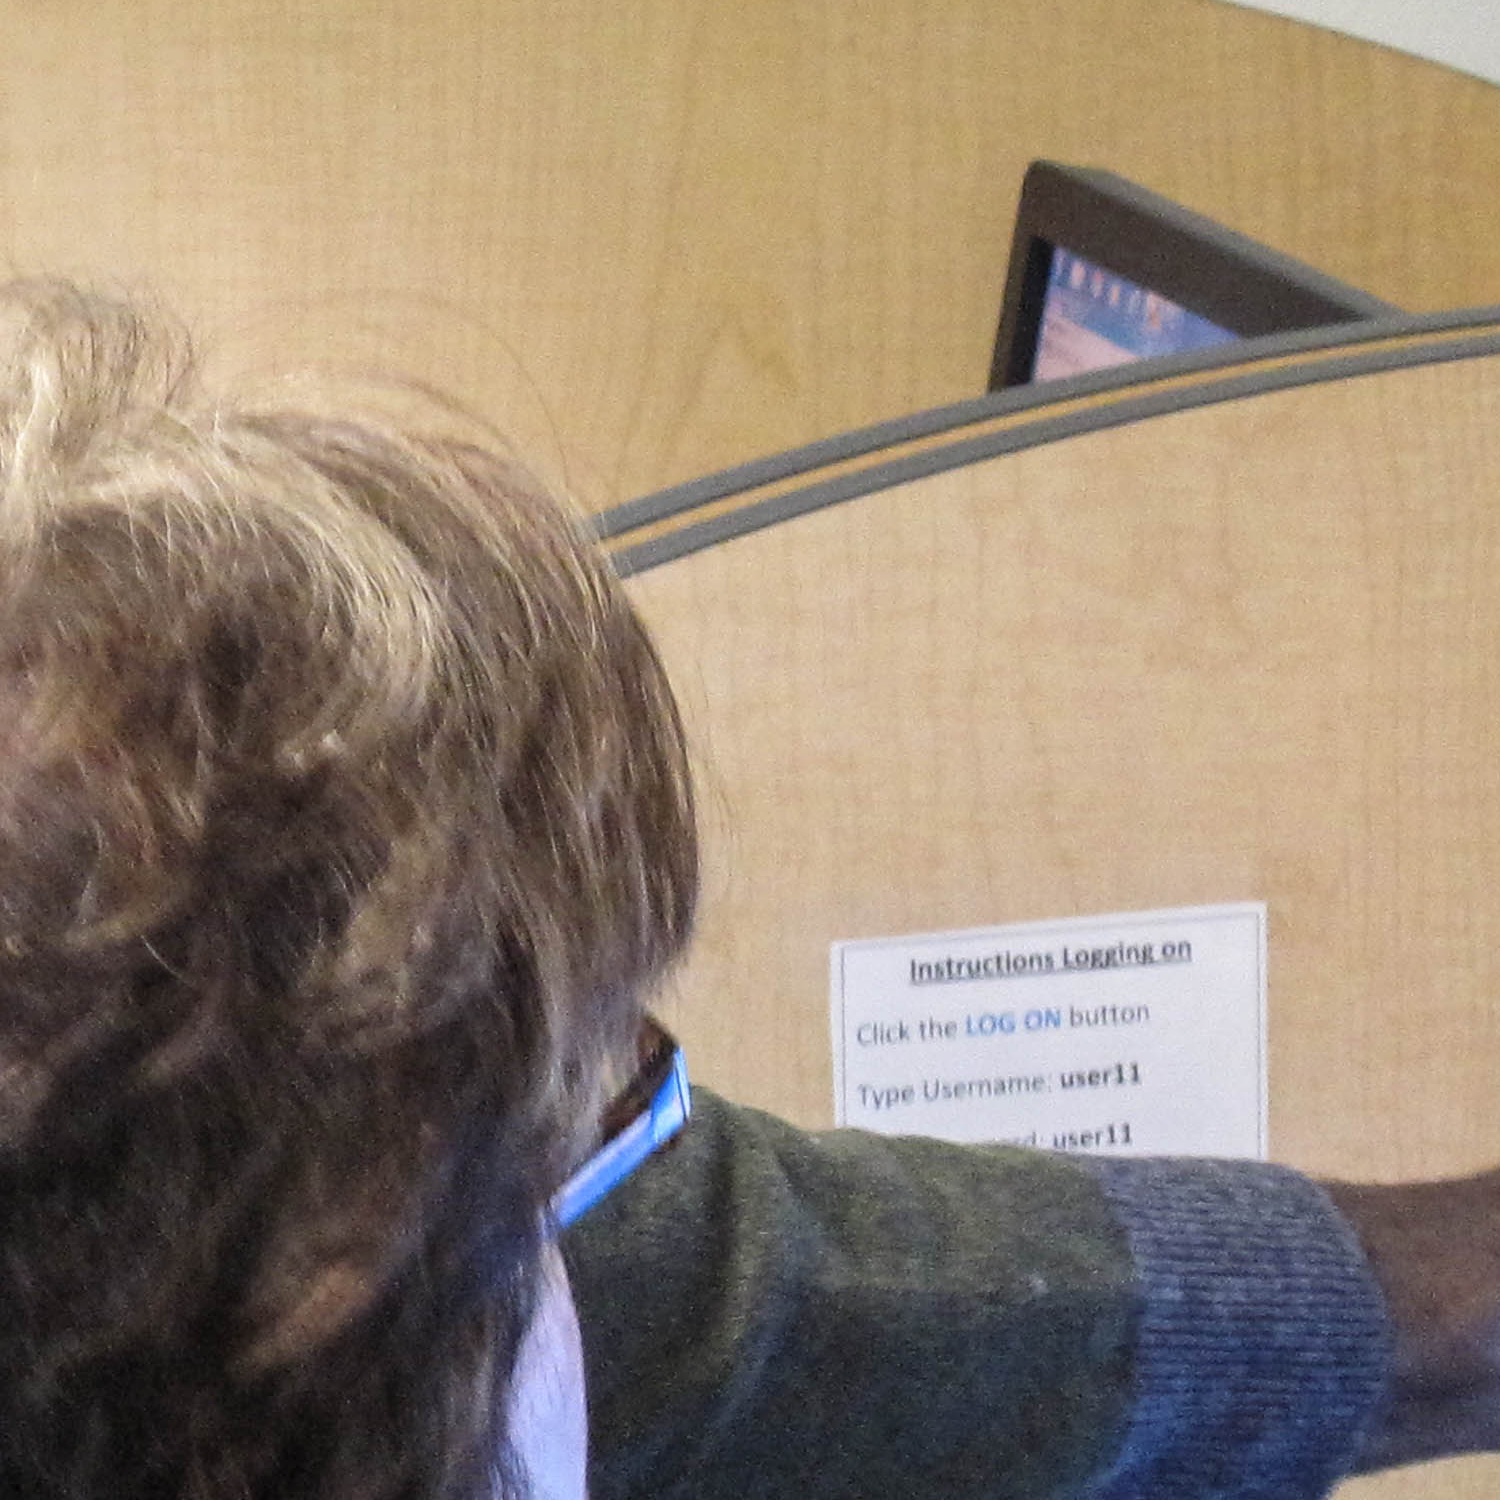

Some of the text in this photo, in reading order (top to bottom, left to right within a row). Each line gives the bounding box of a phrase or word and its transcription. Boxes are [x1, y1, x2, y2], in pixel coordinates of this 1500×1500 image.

[910, 938, 1192, 984] Instructions Logging on
[857, 1004, 1150, 1047] Click the LOG ON button
[858, 1061, 1142, 1111] Type Username: user11
